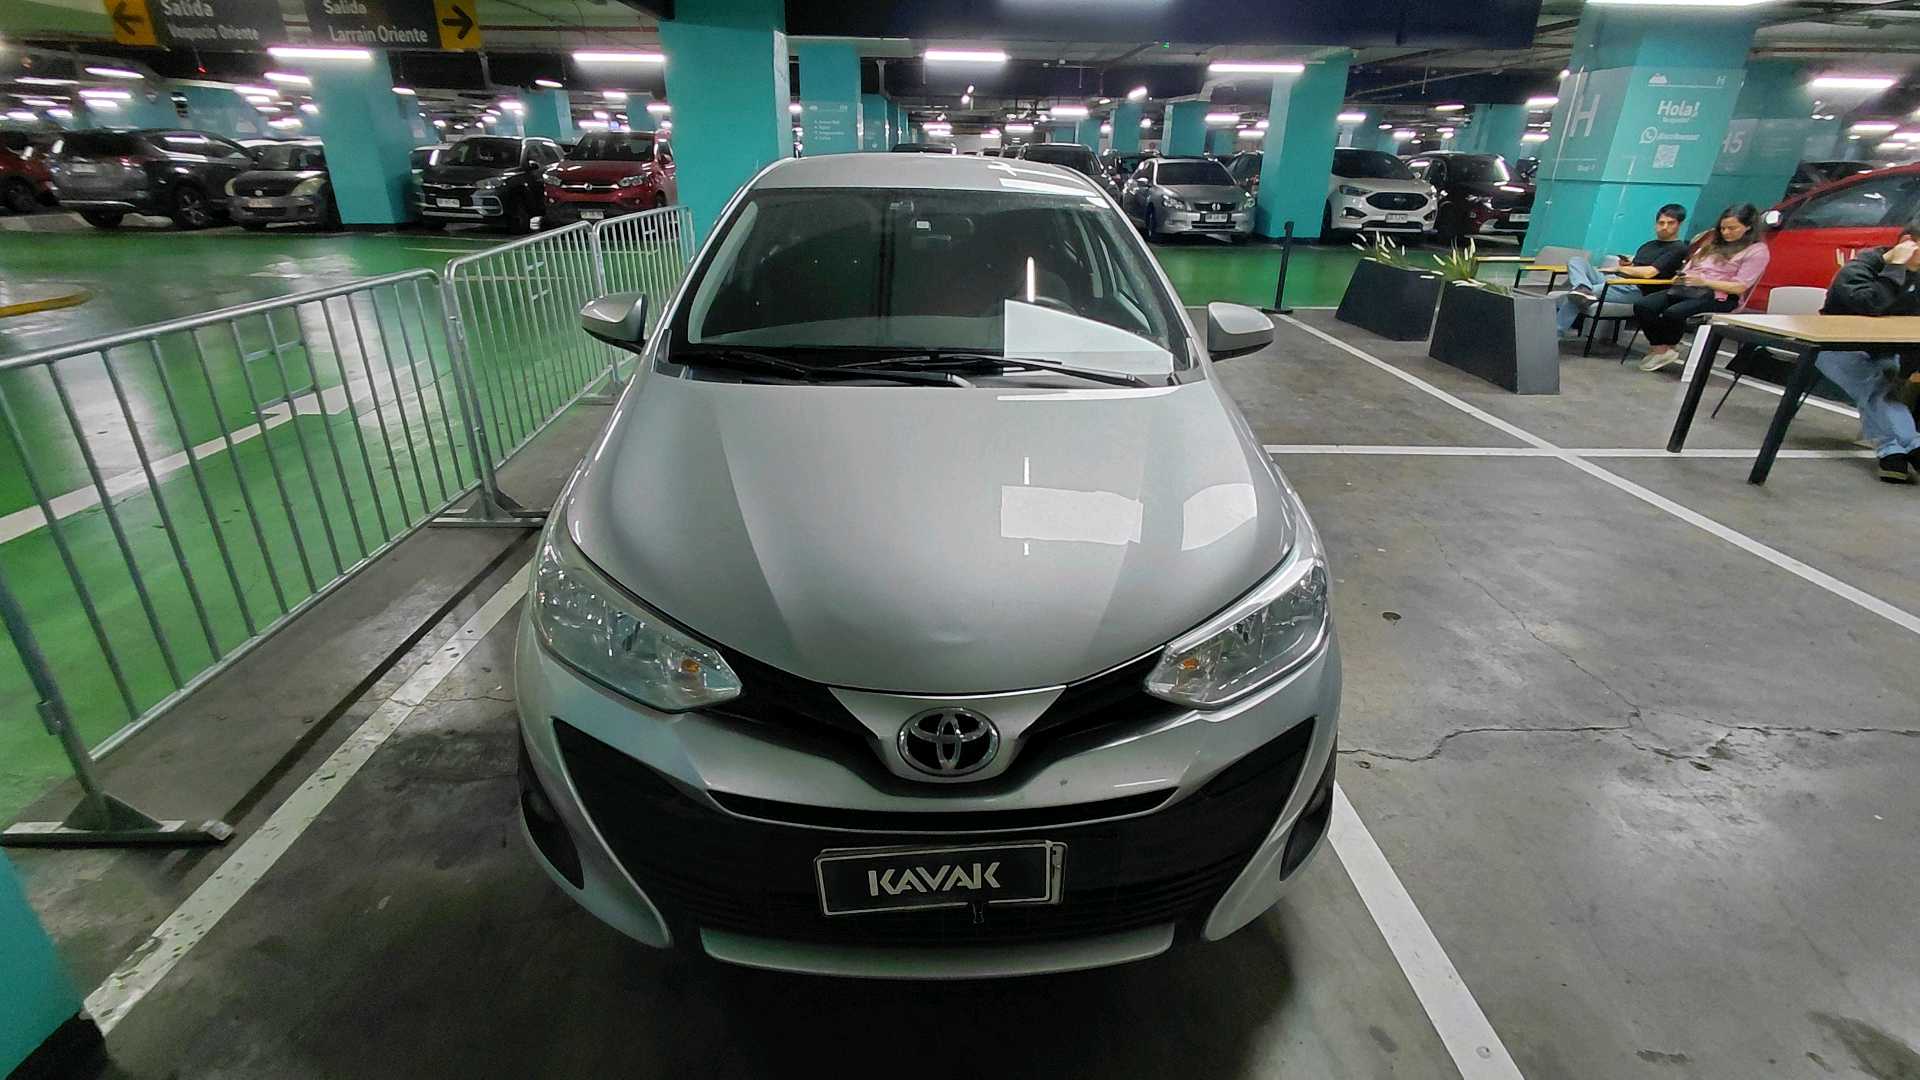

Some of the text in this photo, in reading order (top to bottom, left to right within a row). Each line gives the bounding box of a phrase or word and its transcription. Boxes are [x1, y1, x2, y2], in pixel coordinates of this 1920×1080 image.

[161, 0, 214, 16] Salida
[323, 0, 367, 15] Salida
[377, 25, 428, 43] Oriente
[1569, 94, 1601, 137] H
[1657, 101, 1700, 117] Hola!
[867, 861, 1001, 897] KAVAK
